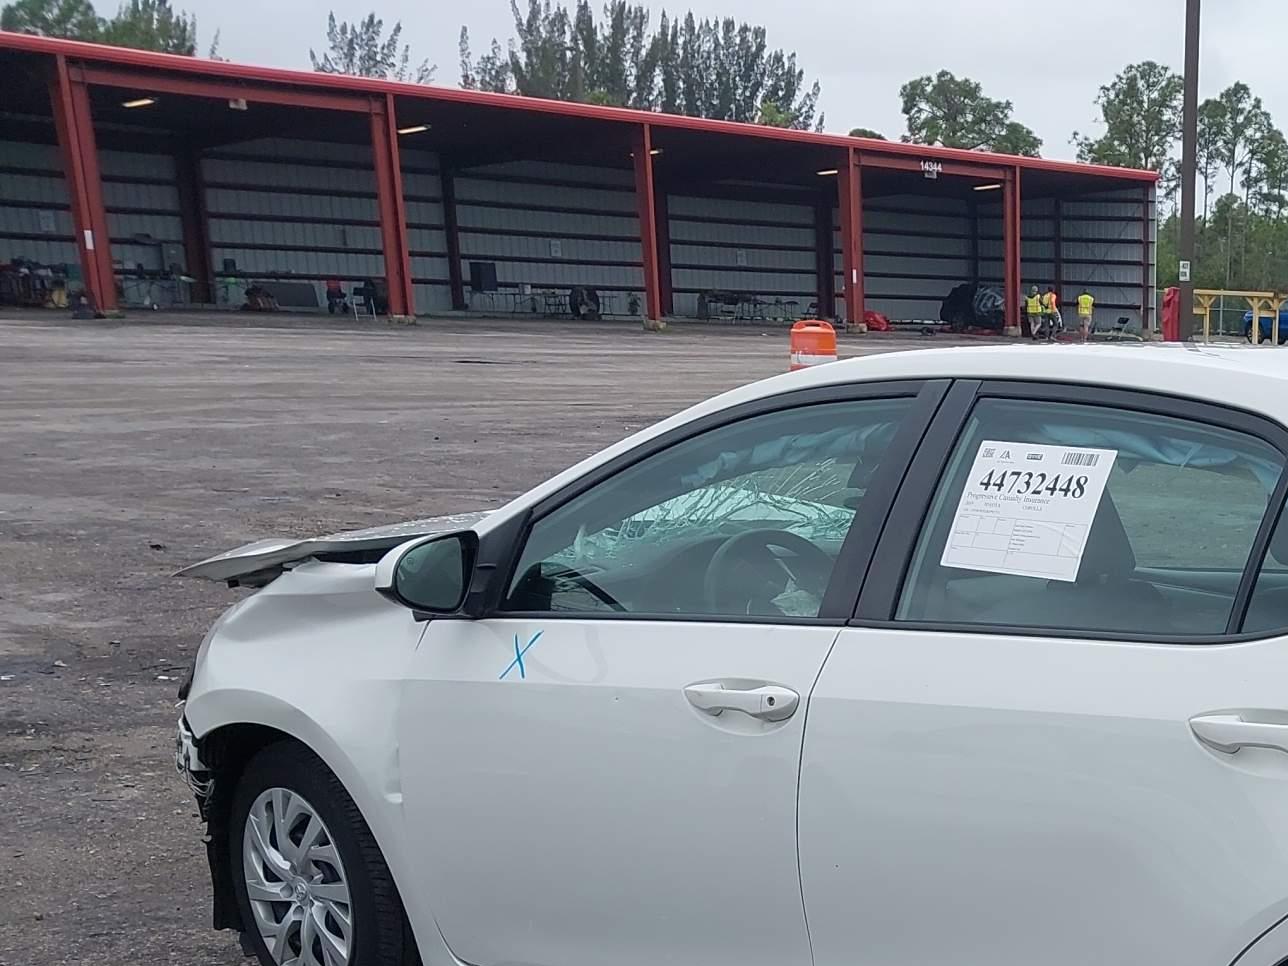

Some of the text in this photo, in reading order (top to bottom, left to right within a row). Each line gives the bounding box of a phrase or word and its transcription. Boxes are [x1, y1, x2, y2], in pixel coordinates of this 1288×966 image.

[920, 160, 942, 172] 14344
[980, 469, 1088, 498] 44732448
[1023, 496, 1051, 505] Insurance
